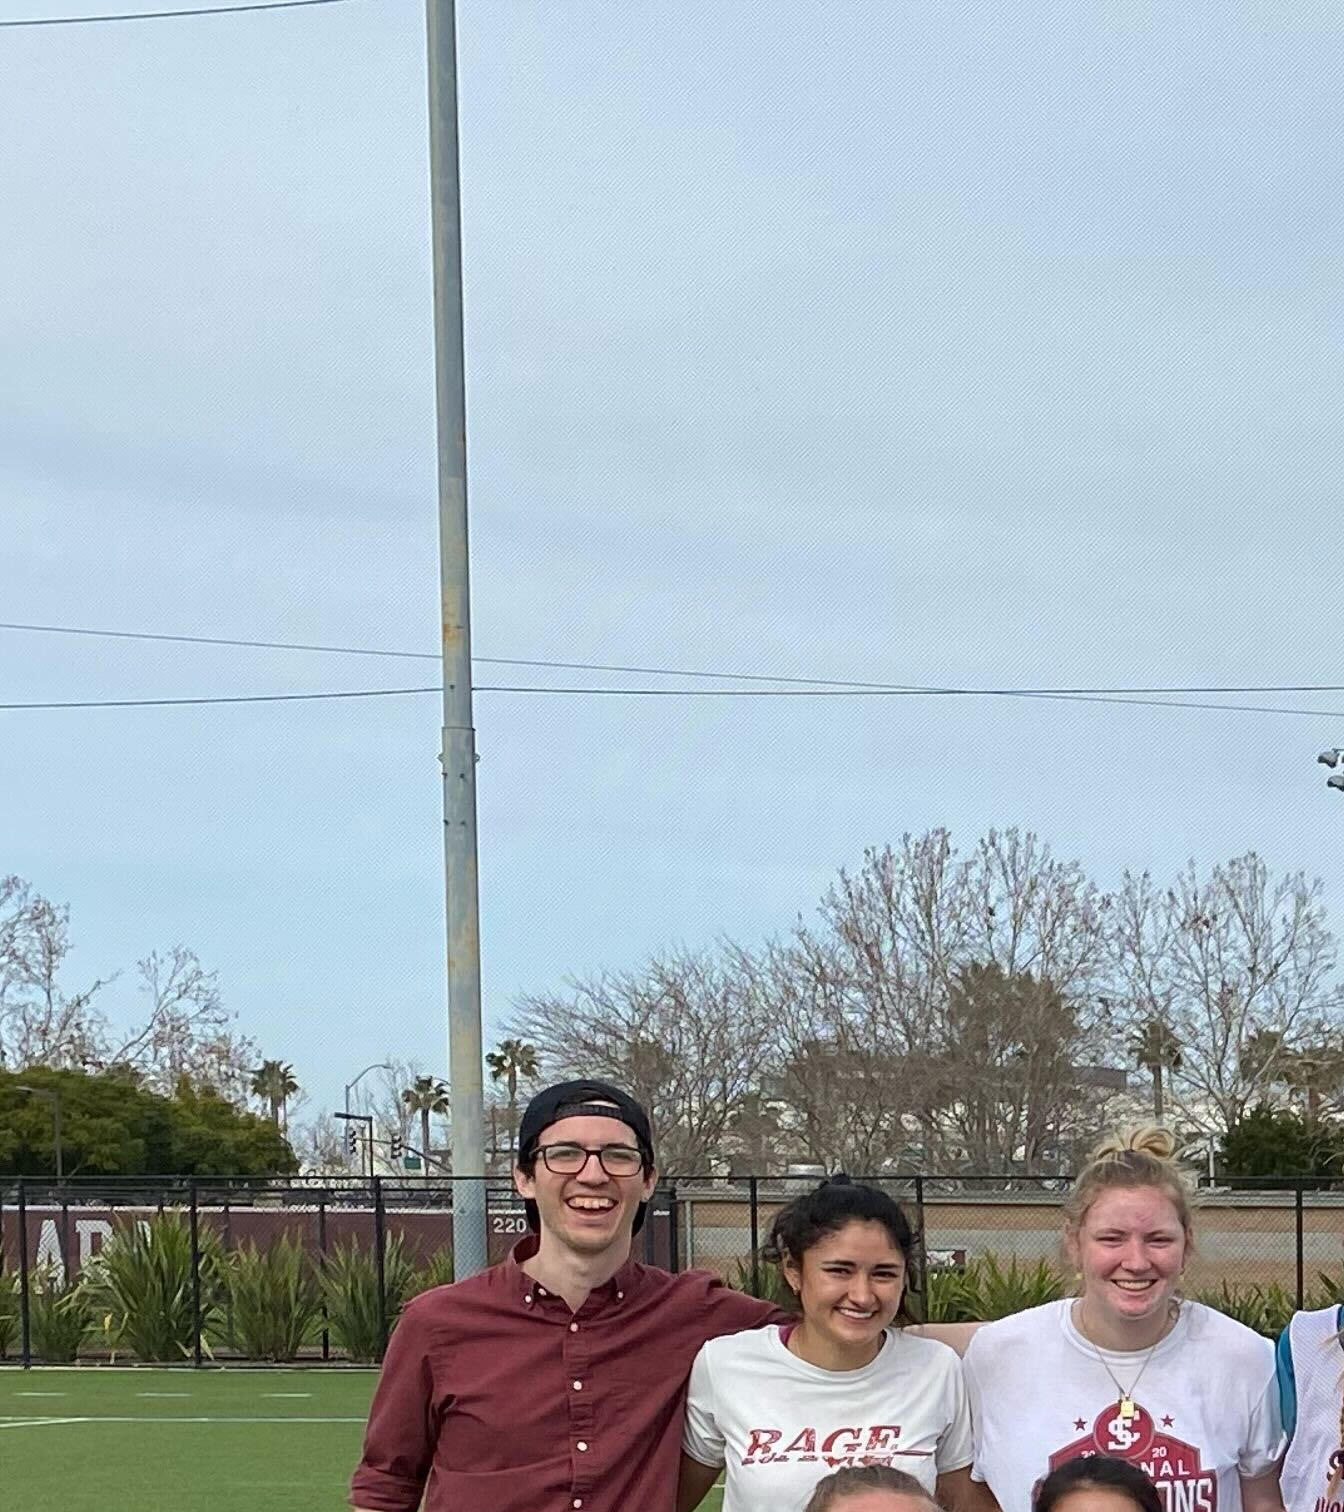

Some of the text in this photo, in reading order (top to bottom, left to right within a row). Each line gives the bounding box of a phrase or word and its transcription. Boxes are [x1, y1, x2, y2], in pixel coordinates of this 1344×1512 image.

[493, 1217, 527, 1233] 220
[741, 1425, 902, 1467] RAGE
[1152, 1447, 1167, 1457] 20
